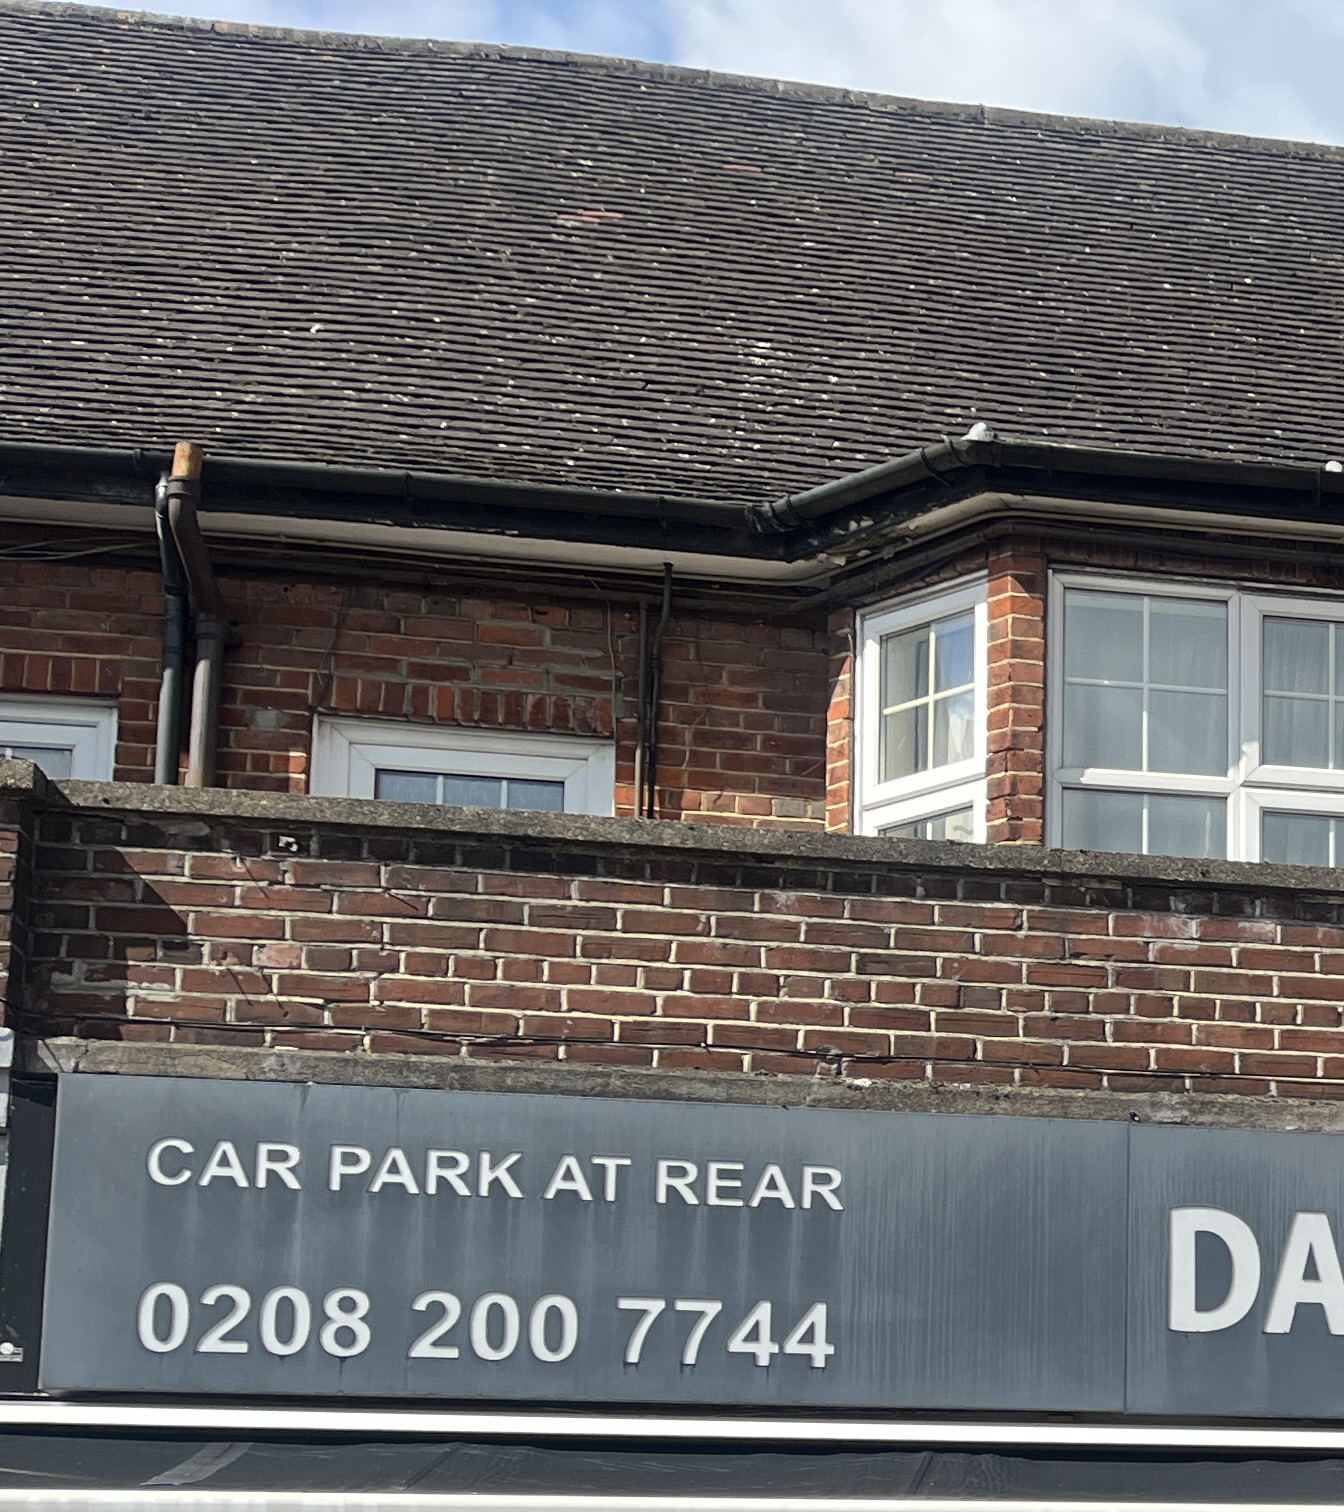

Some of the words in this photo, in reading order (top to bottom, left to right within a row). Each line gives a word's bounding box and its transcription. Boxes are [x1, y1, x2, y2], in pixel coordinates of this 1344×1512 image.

[147, 1138, 303, 1191] CAR
[329, 1145, 524, 1199] PARK
[543, 1155, 633, 1203] AT
[656, 1159, 845, 1211] REAR
[138, 1282, 372, 1358] 0208
[408, 1290, 579, 1363] 200
[616, 1297, 836, 1369] 7744
